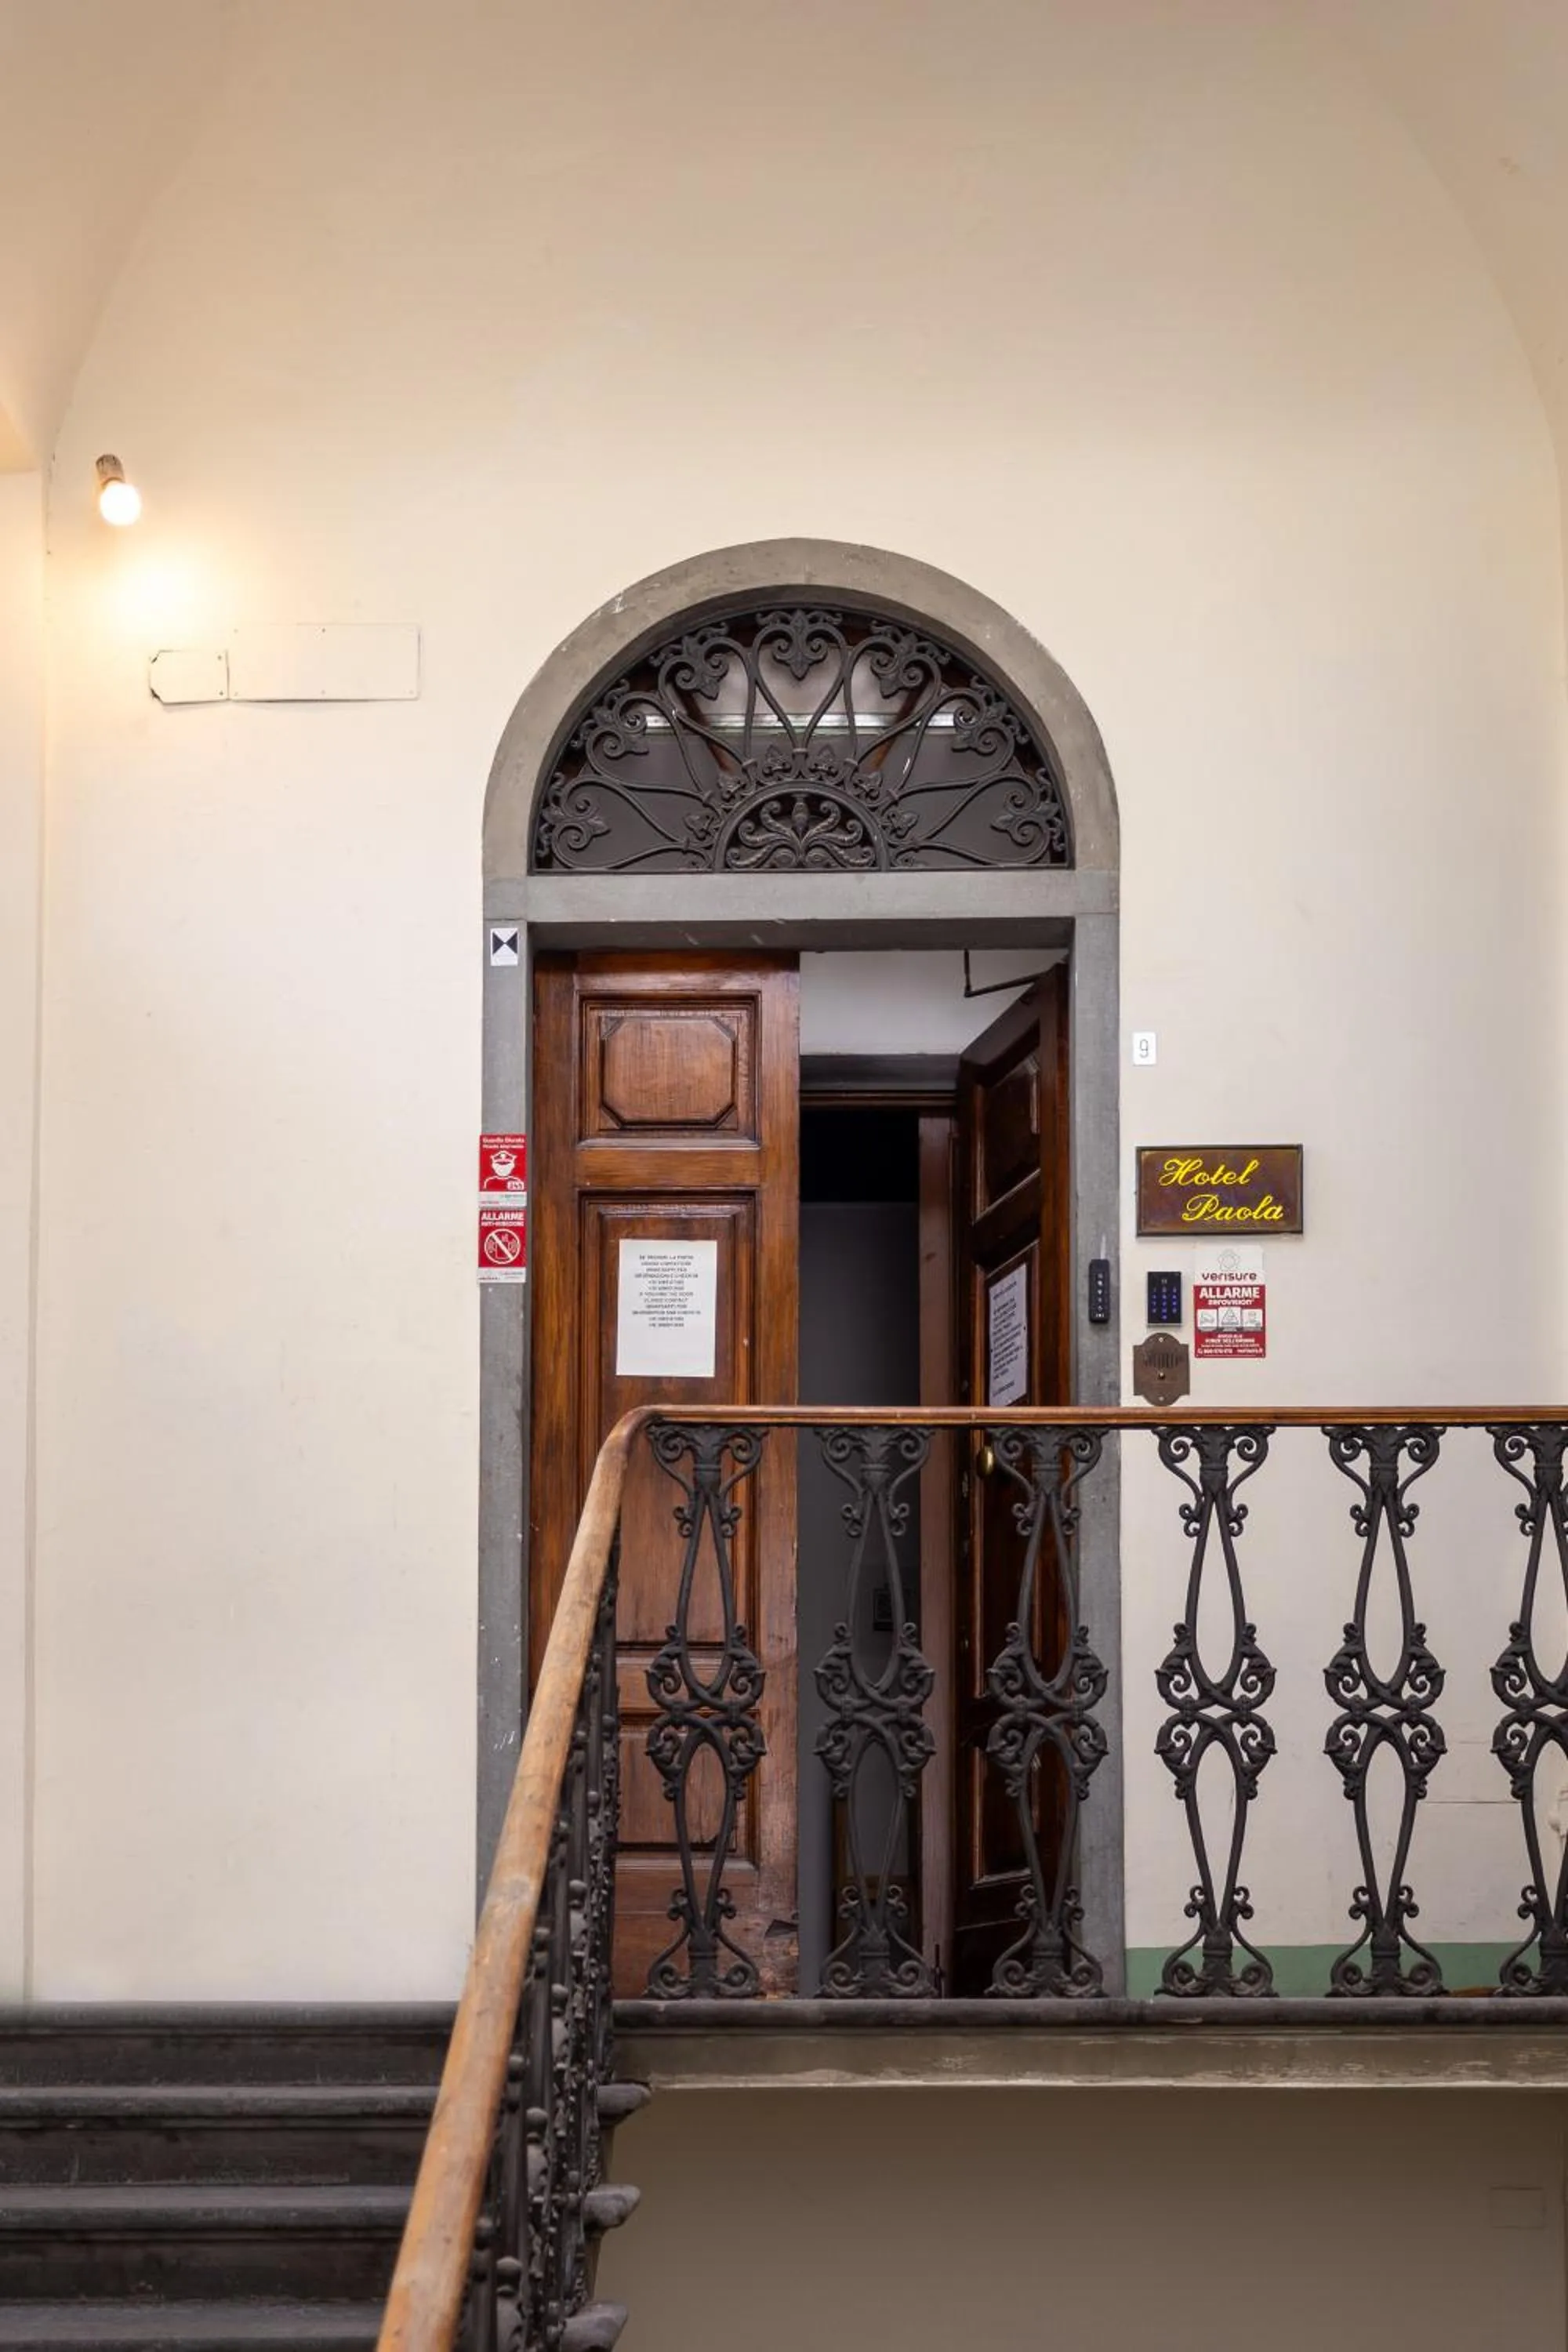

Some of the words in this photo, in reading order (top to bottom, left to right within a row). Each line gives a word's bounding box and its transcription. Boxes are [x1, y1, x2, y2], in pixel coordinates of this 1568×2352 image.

[1140, 1039, 1149, 1058] 9
[1159, 1158, 1260, 1186] Hotel
[1181, 1194, 1284, 1221] Paola
[1200, 1287, 1260, 1298] ALLARME
